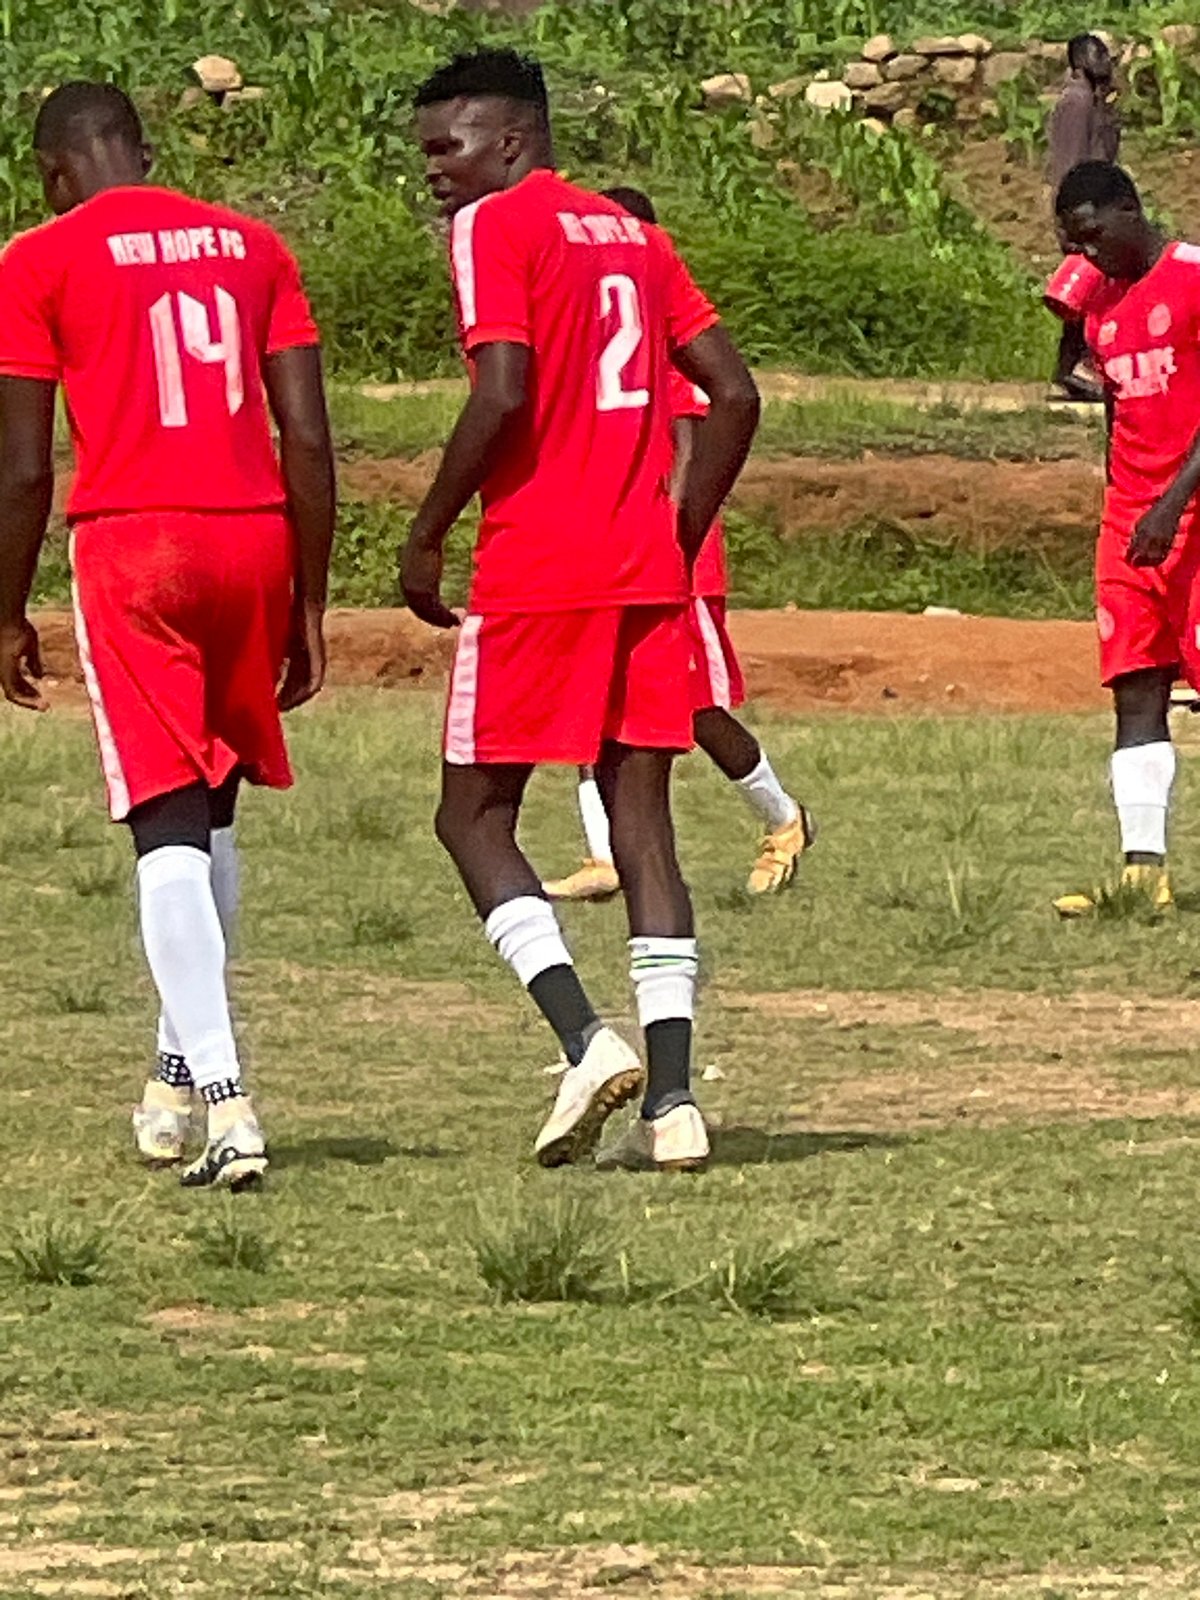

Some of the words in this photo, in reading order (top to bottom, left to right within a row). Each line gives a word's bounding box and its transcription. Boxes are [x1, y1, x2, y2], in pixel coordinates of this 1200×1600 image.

[106, 231, 157, 266] NEW
[158, 225, 219, 264] HOPE
[217, 227, 246, 260] FC
[149, 284, 244, 427] 14
[596, 273, 650, 411] 2
